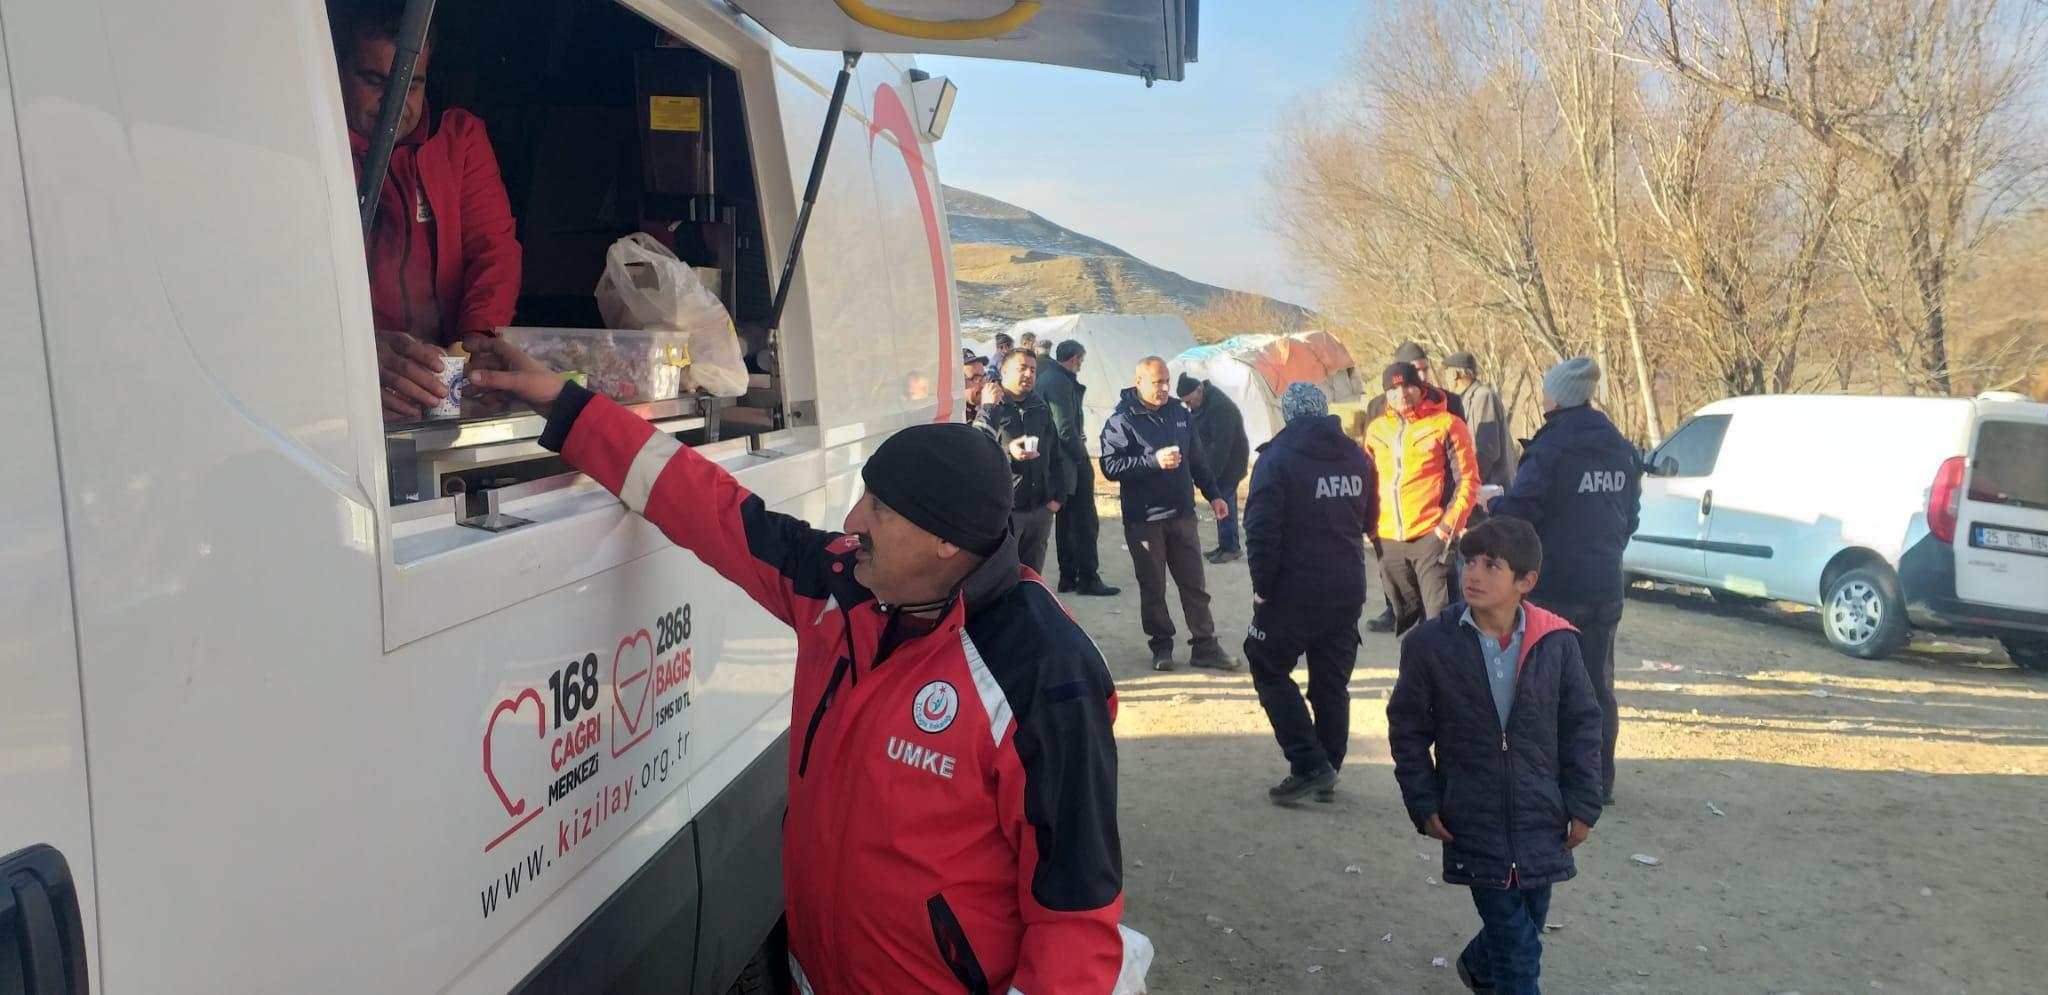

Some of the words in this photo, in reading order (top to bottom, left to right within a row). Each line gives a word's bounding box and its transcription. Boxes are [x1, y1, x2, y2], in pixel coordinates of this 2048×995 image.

[1315, 474, 1363, 499] AFAD
[1577, 470, 1626, 493] AFAD
[656, 603, 691, 656] 2868
[548, 652, 599, 730] 168
[674, 695, 683, 715] 10
[550, 711, 601, 773] ÇAĞRI
[887, 736, 957, 779] UMKE
